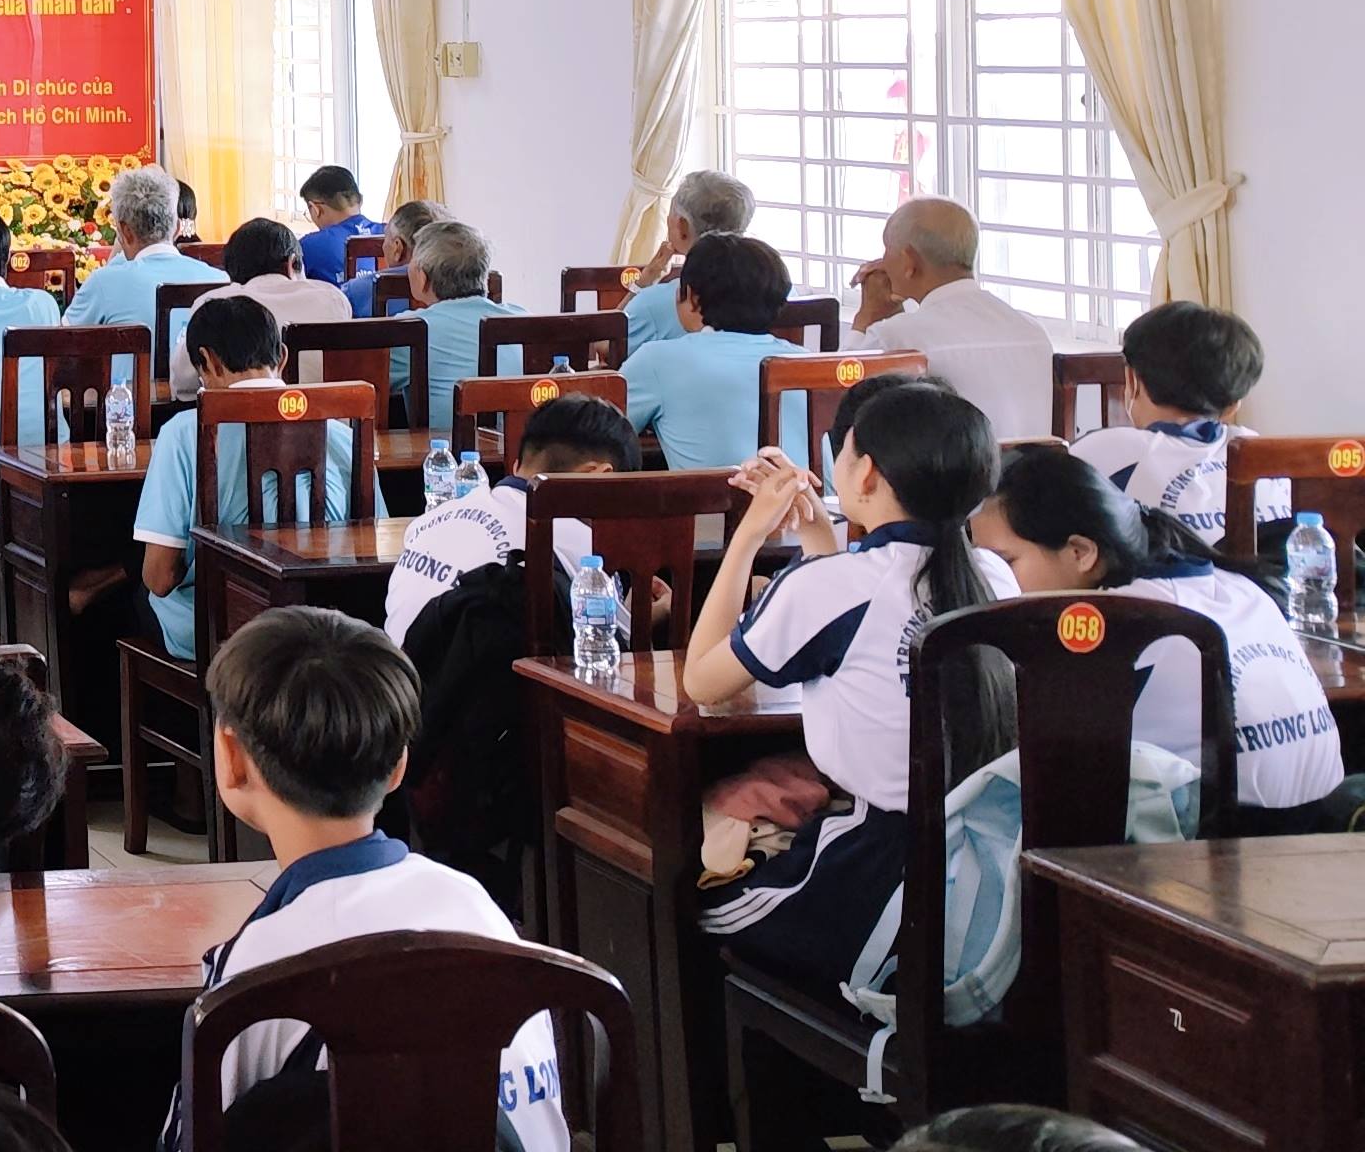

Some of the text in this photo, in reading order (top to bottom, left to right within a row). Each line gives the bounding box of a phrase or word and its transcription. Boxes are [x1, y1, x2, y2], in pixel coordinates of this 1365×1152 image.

[280, 396, 305, 414] 094
[1331, 450, 1361, 468] 095
[1062, 614, 1099, 641] 058
